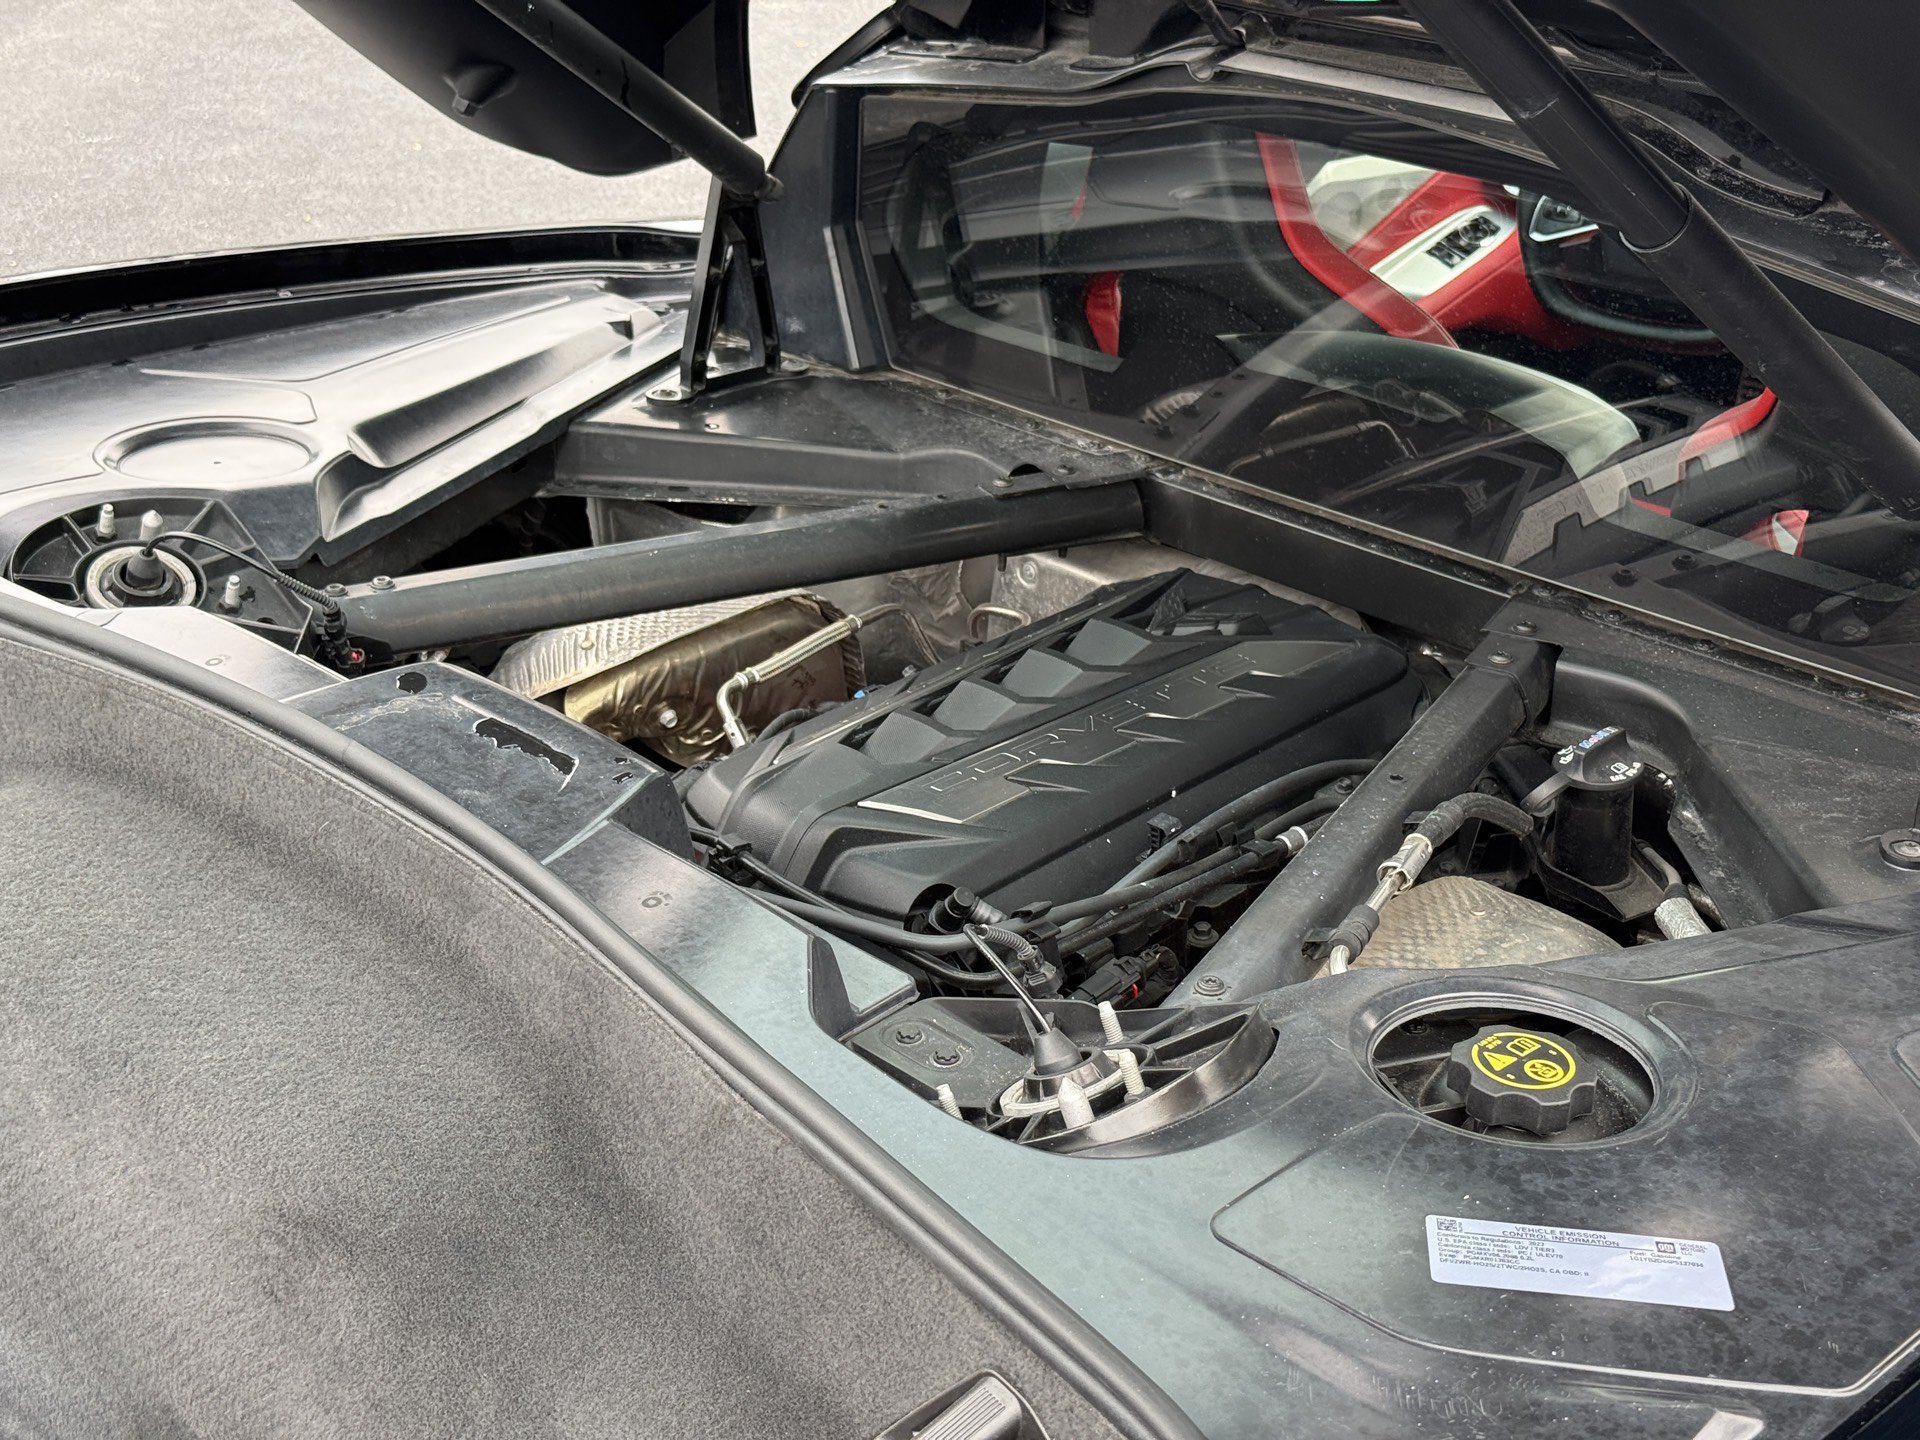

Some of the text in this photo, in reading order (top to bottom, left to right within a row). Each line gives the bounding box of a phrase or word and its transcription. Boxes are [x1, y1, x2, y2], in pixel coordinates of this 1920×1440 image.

[1501, 1230, 1619, 1246] CONTROL INFORMATION
[1514, 1226, 1606, 1240] VEHICLE EMISSION
